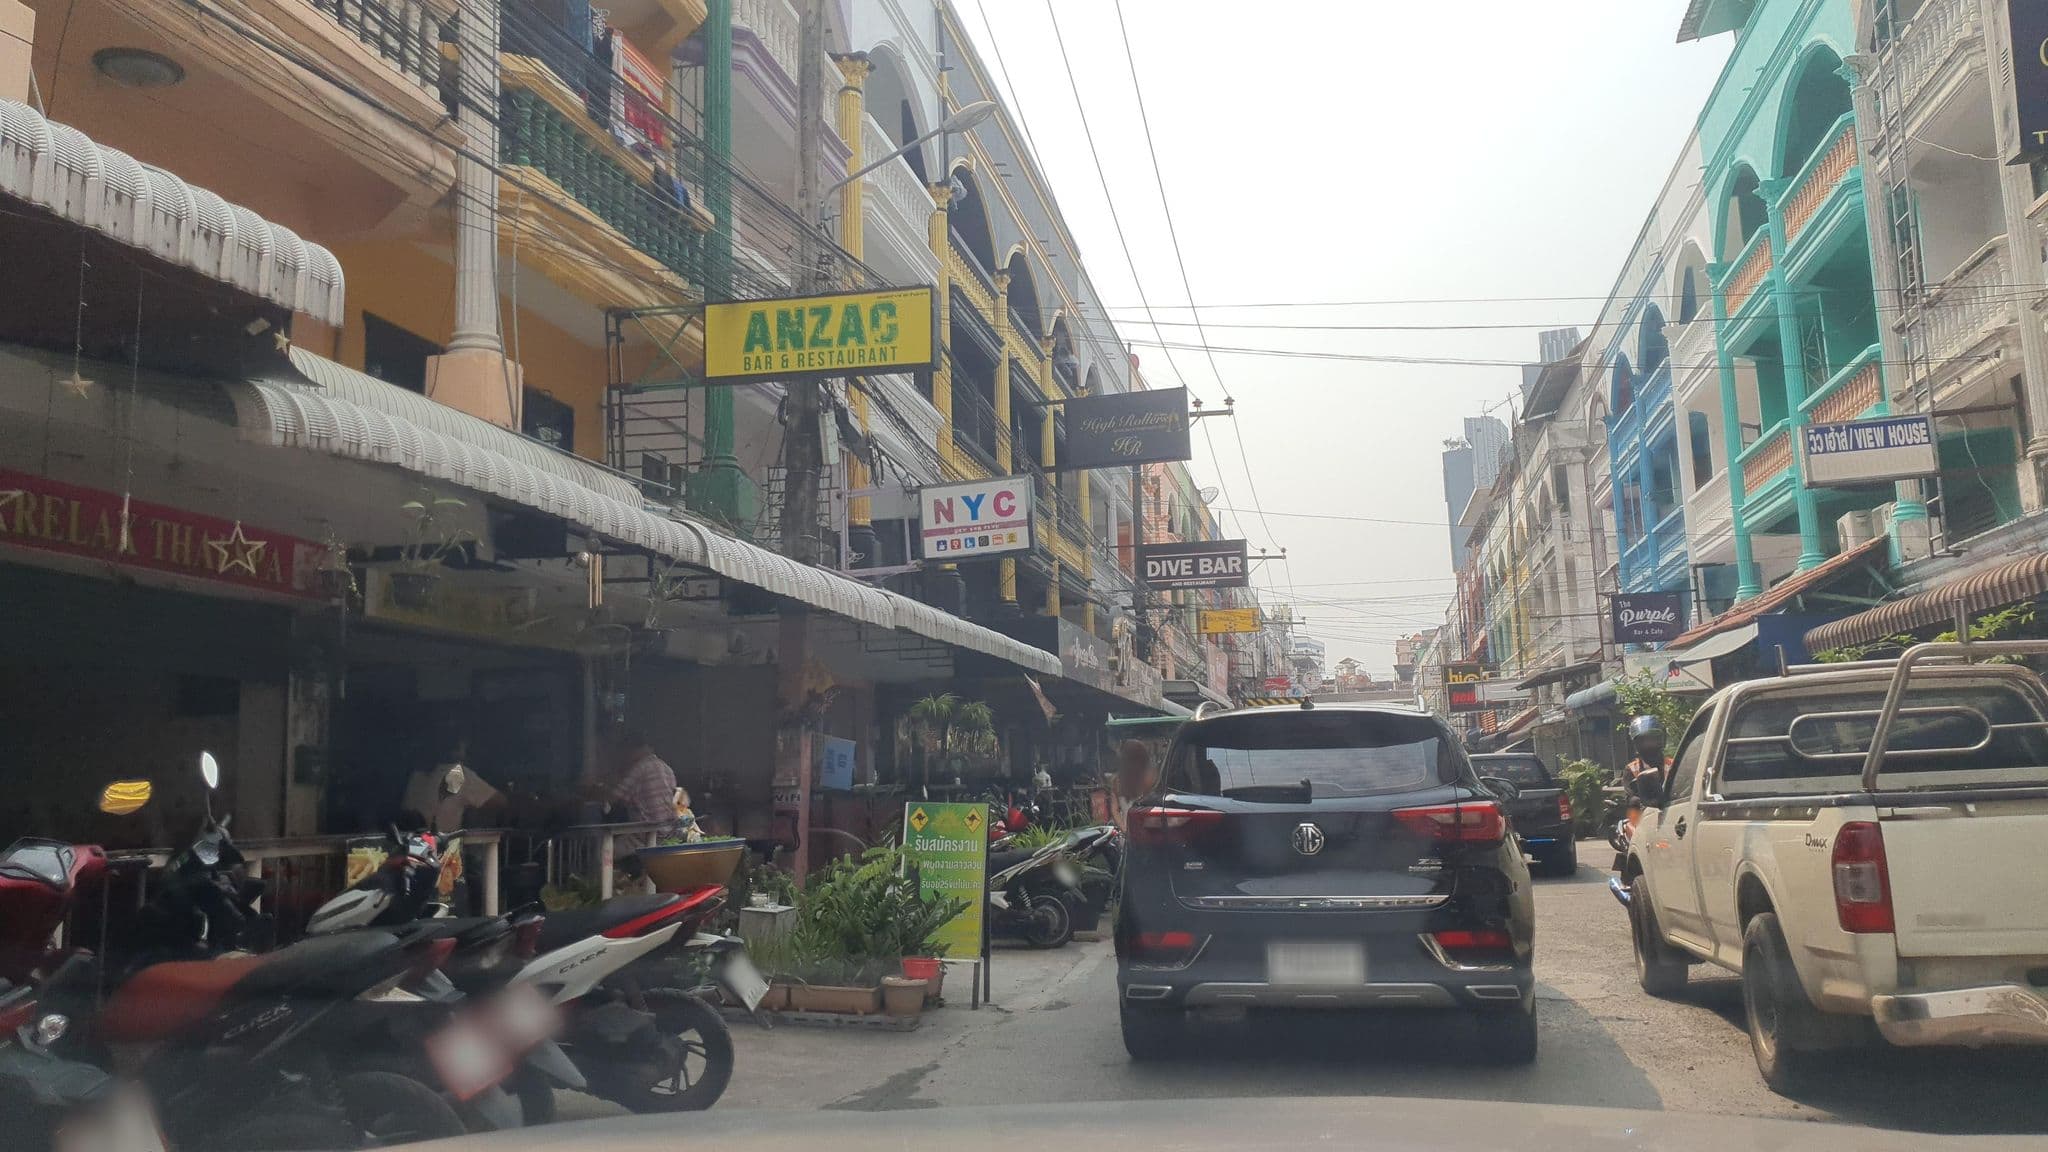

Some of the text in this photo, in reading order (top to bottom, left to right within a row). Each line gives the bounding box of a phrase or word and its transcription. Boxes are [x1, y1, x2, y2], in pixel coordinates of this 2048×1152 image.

[743, 300, 899, 353] ANZAC
[743, 346, 898, 372] BAR & RESTAURANT
[1080, 416, 1116, 433] High
[1854, 425, 1885, 449] VIEW
[1888, 422, 1930, 446] HOUSE
[933, 490, 1017, 525] NYC
[1147, 556, 1242, 577] DIVE BAR
[1620, 607, 1676, 627] Purple
[560, 947, 608, 974] CLICK
